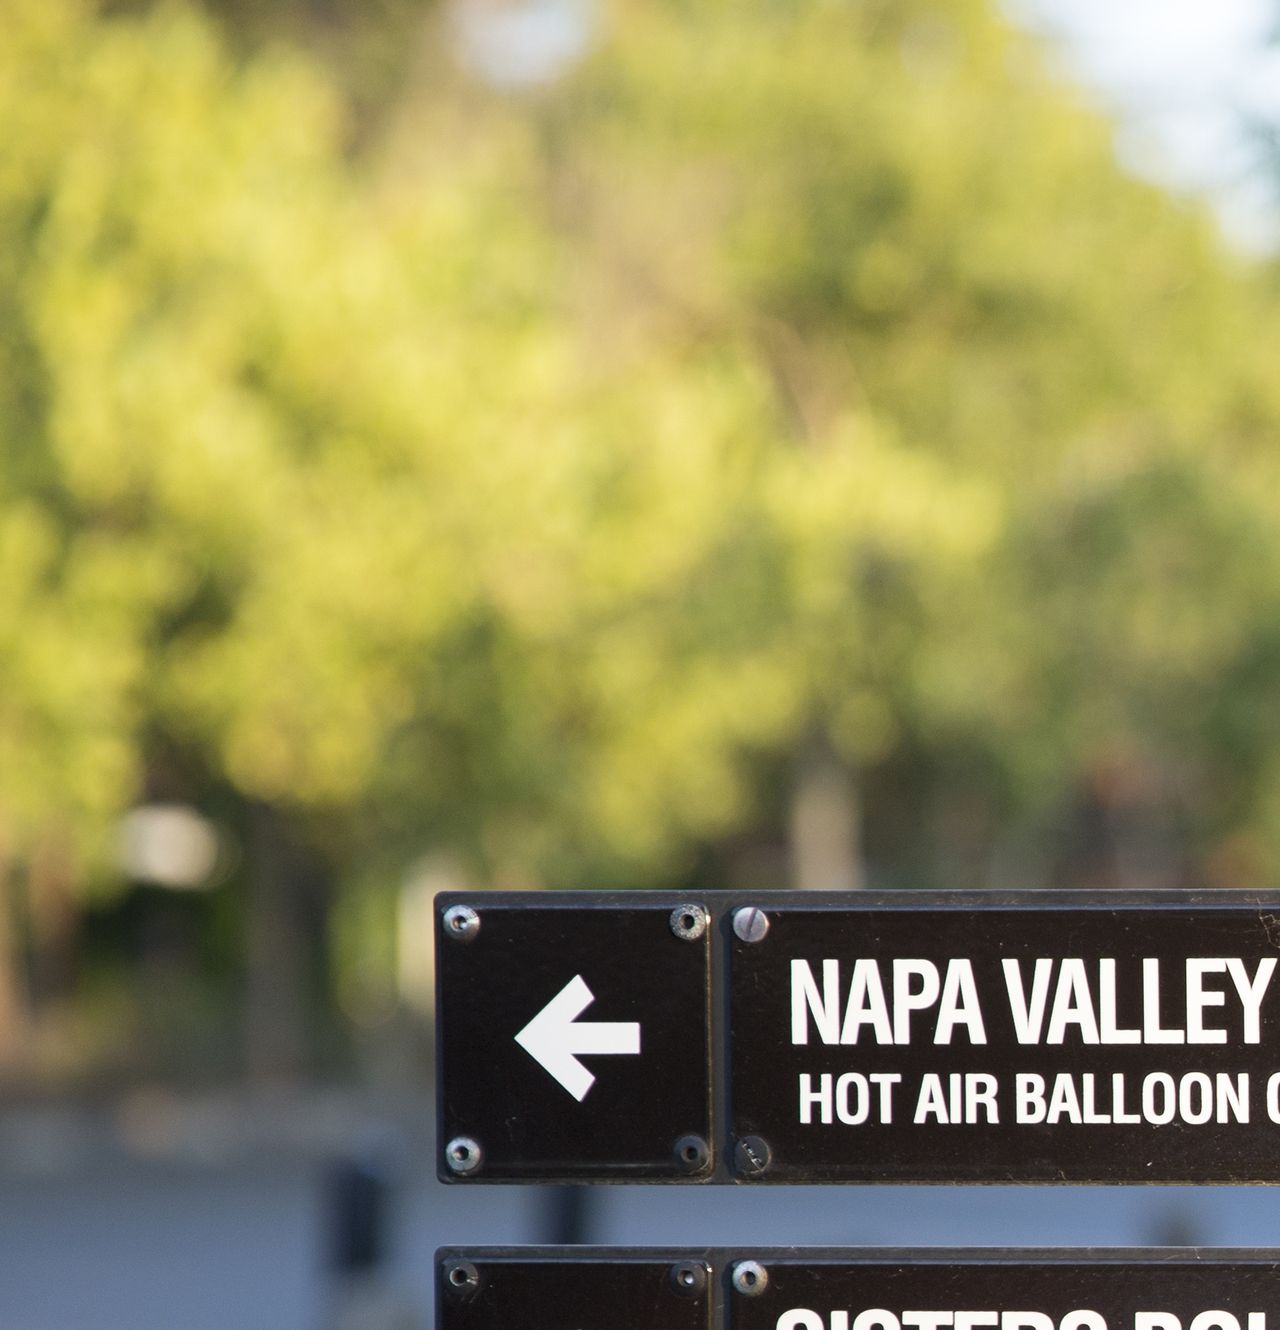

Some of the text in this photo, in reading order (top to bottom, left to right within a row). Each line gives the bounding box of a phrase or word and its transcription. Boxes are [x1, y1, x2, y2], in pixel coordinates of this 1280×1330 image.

[790, 958, 988, 1045] NAPA
[1001, 957, 1278, 1045] VALLEY
[799, 1072, 902, 1126] HOT
[913, 1072, 1000, 1124] AIR
[1015, 1071, 1250, 1126] BALLOON
